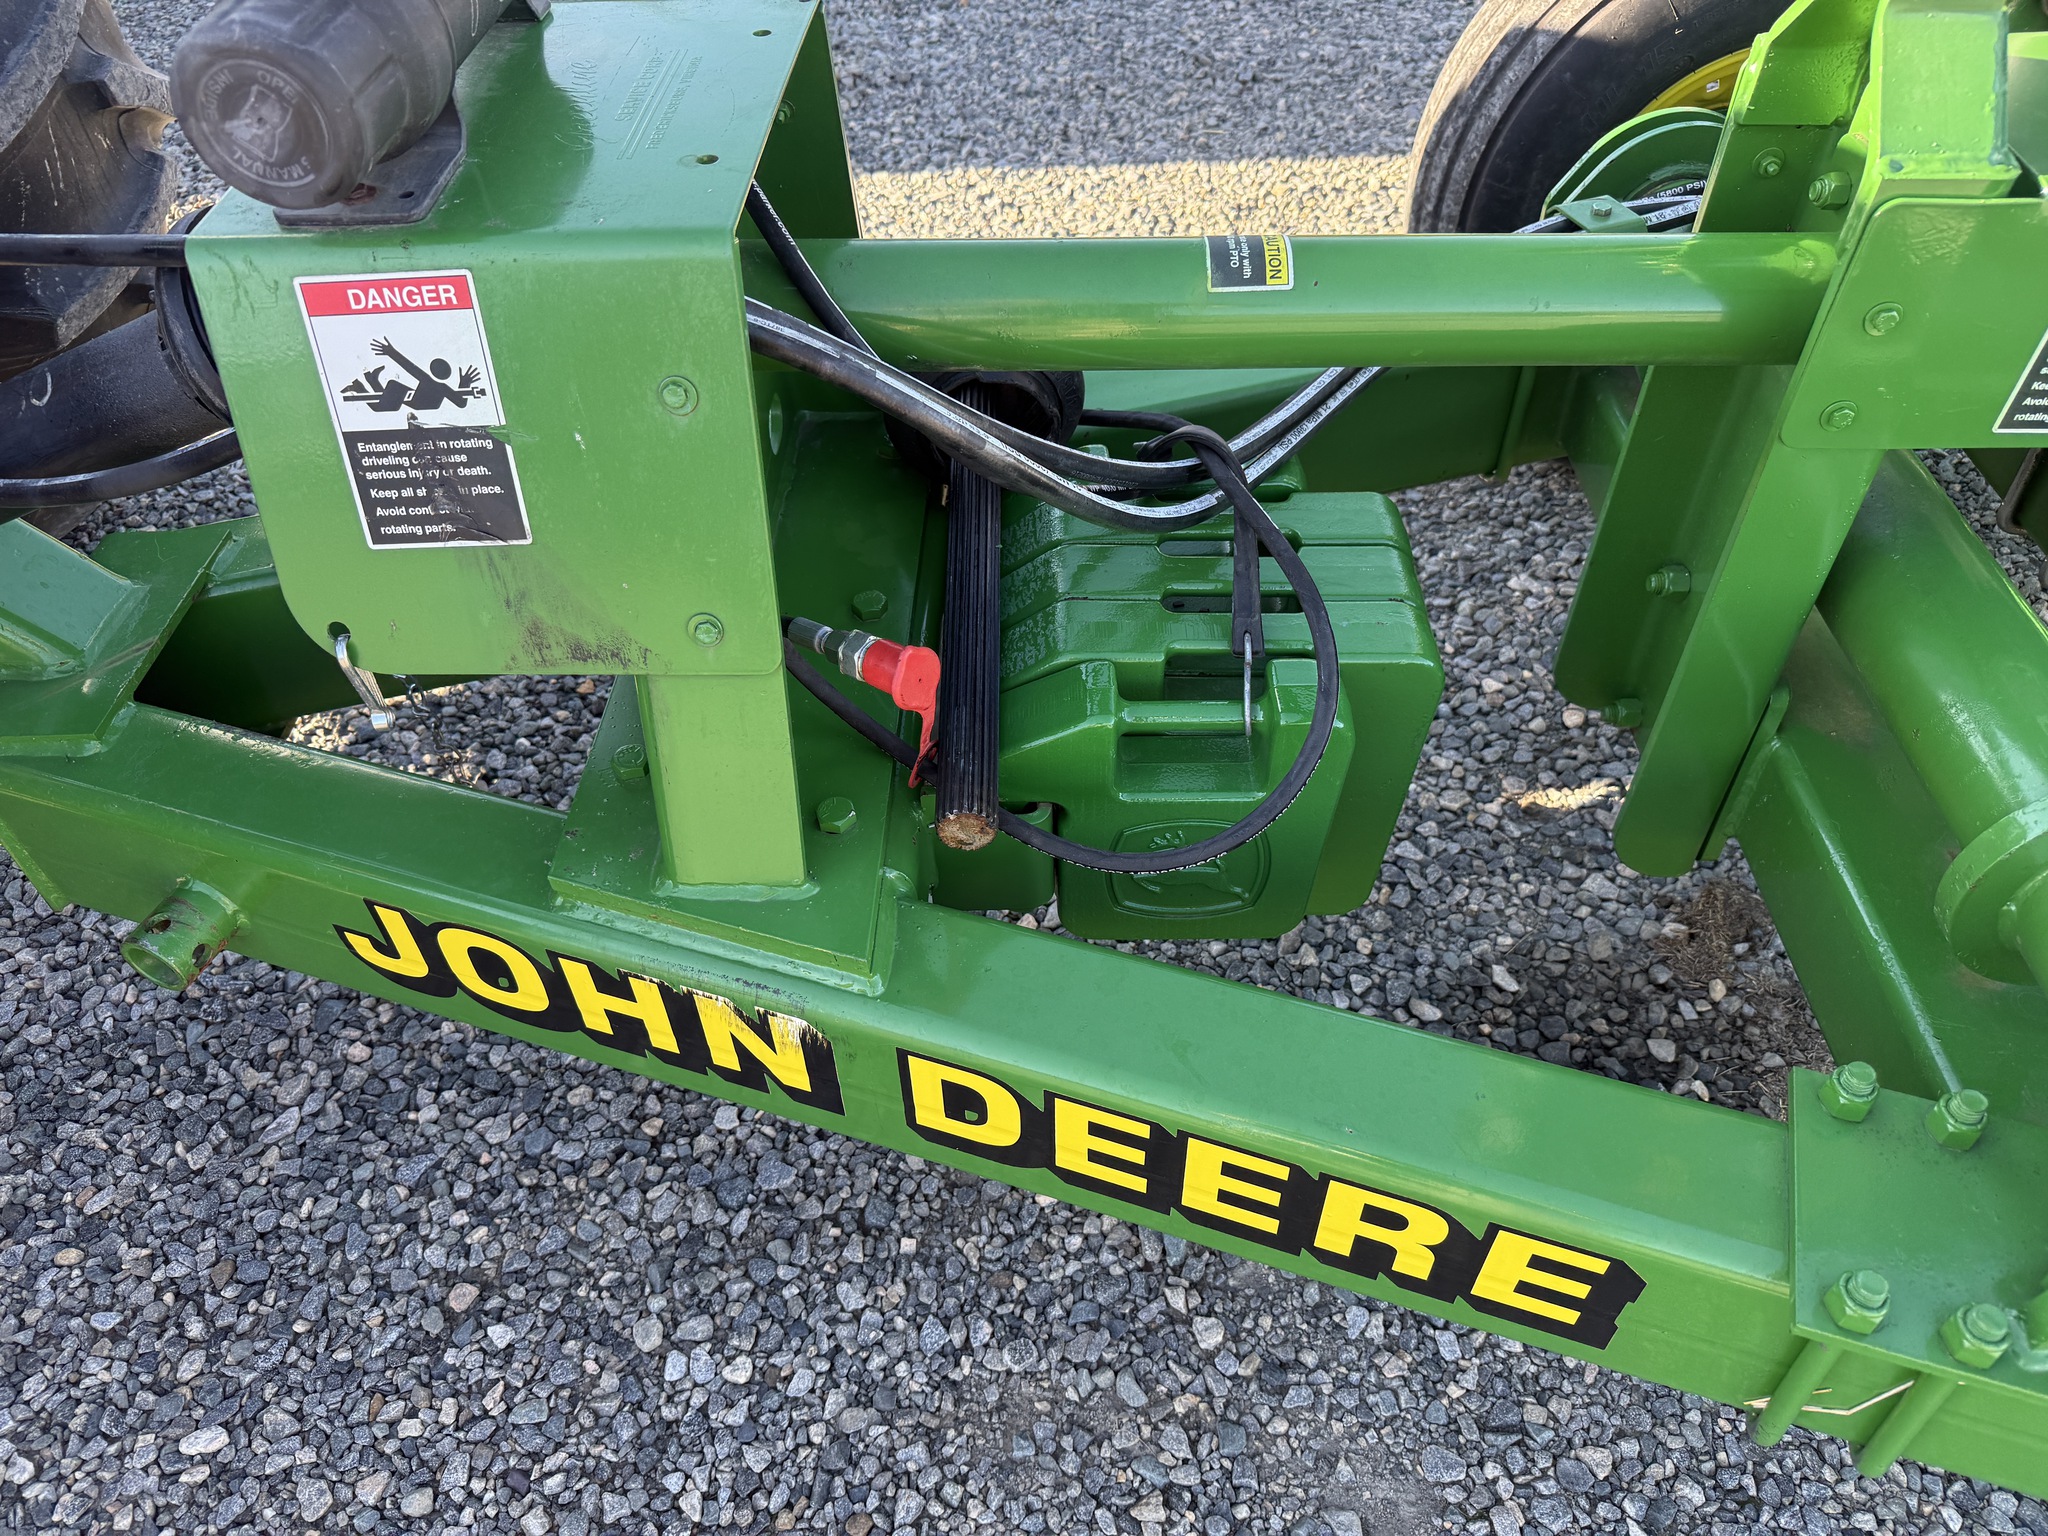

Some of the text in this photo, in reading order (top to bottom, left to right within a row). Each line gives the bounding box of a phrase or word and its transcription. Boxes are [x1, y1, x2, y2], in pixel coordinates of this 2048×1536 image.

[1240, 243, 1251, 257] only
[1265, 235, 1282, 280] AUTION
[1230, 250, 1240, 268] PTO
[1242, 258, 1252, 279] with
[347, 285, 459, 310] DANGER
[357, 441, 434, 454] Entanglemnt
[449, 437, 493, 449] rotating
[361, 455, 414, 467] driveling
[436, 454, 468, 463] cause
[365, 471, 407, 480] serious
[408, 468, 440, 481] injry
[457, 466, 492, 477] death.
[370, 487, 399, 500] Keep
[401, 486, 415, 497] all
[471, 484, 505, 496] place.
[376, 506, 406, 517] Avoid
[380, 524, 423, 536] rotating
[343, 905, 1611, 1325] JOHN DEERE
